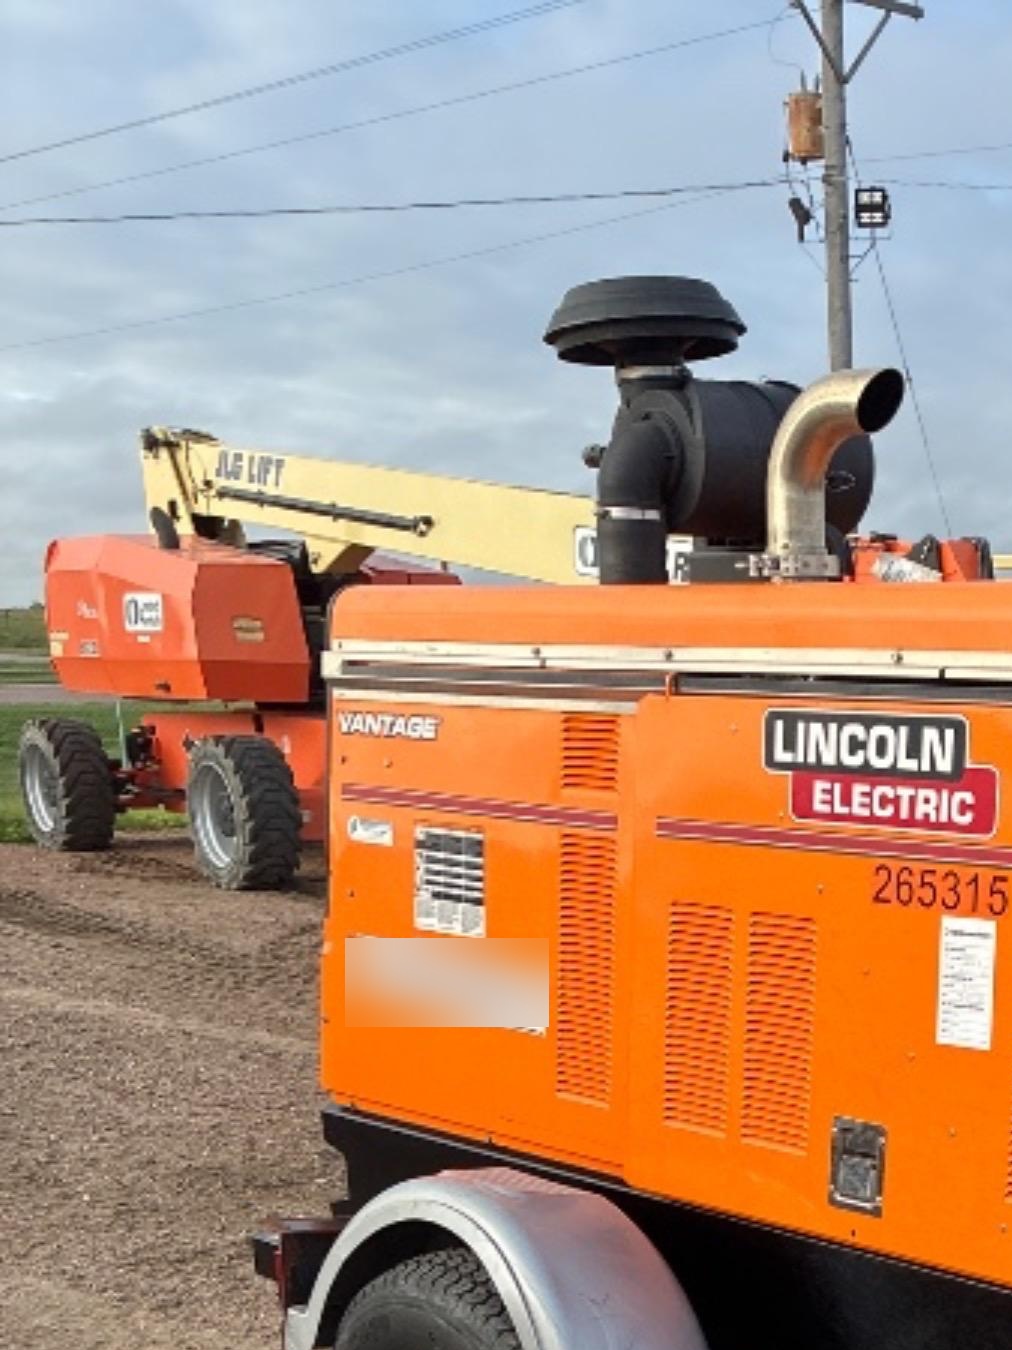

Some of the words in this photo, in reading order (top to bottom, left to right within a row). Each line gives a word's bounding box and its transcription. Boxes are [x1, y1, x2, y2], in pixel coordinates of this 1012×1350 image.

[215, 450, 244, 480] JLG
[247, 454, 286, 488] LIFT
[337, 710, 443, 741] VANTAGE
[773, 719, 956, 773] LINCOLN
[812, 779, 976, 826] ELECTRIC
[873, 863, 1010, 917] 265315
